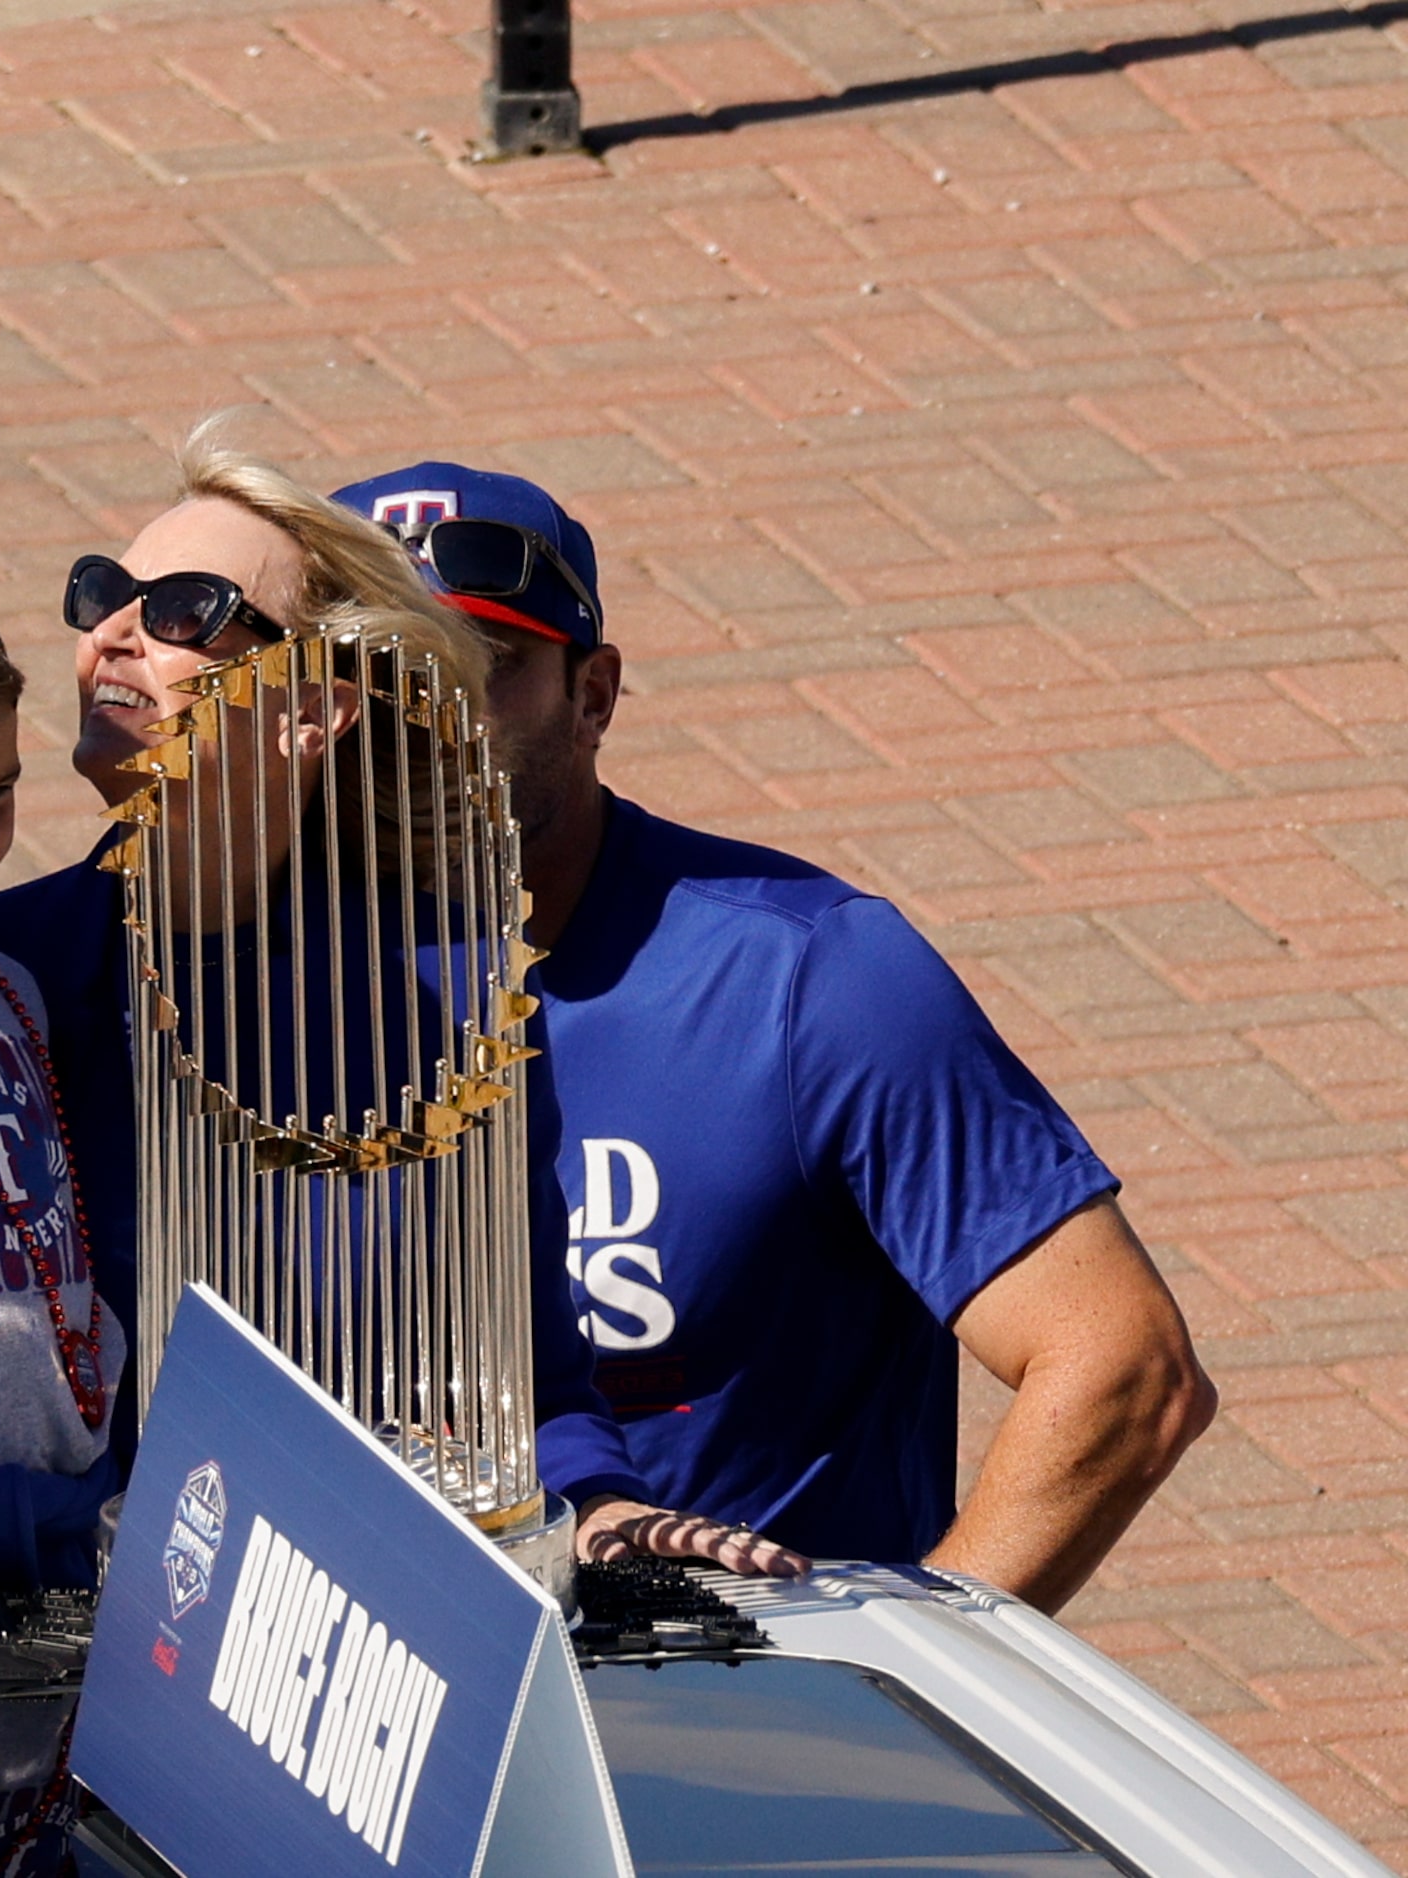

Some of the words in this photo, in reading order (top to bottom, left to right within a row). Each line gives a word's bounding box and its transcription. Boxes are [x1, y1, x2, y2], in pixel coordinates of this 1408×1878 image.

[568, 1138, 660, 1239] D
[567, 1243, 676, 1350] S
[209, 1515, 348, 1781] BRUCE
[305, 1602, 448, 1866] BOCHY
